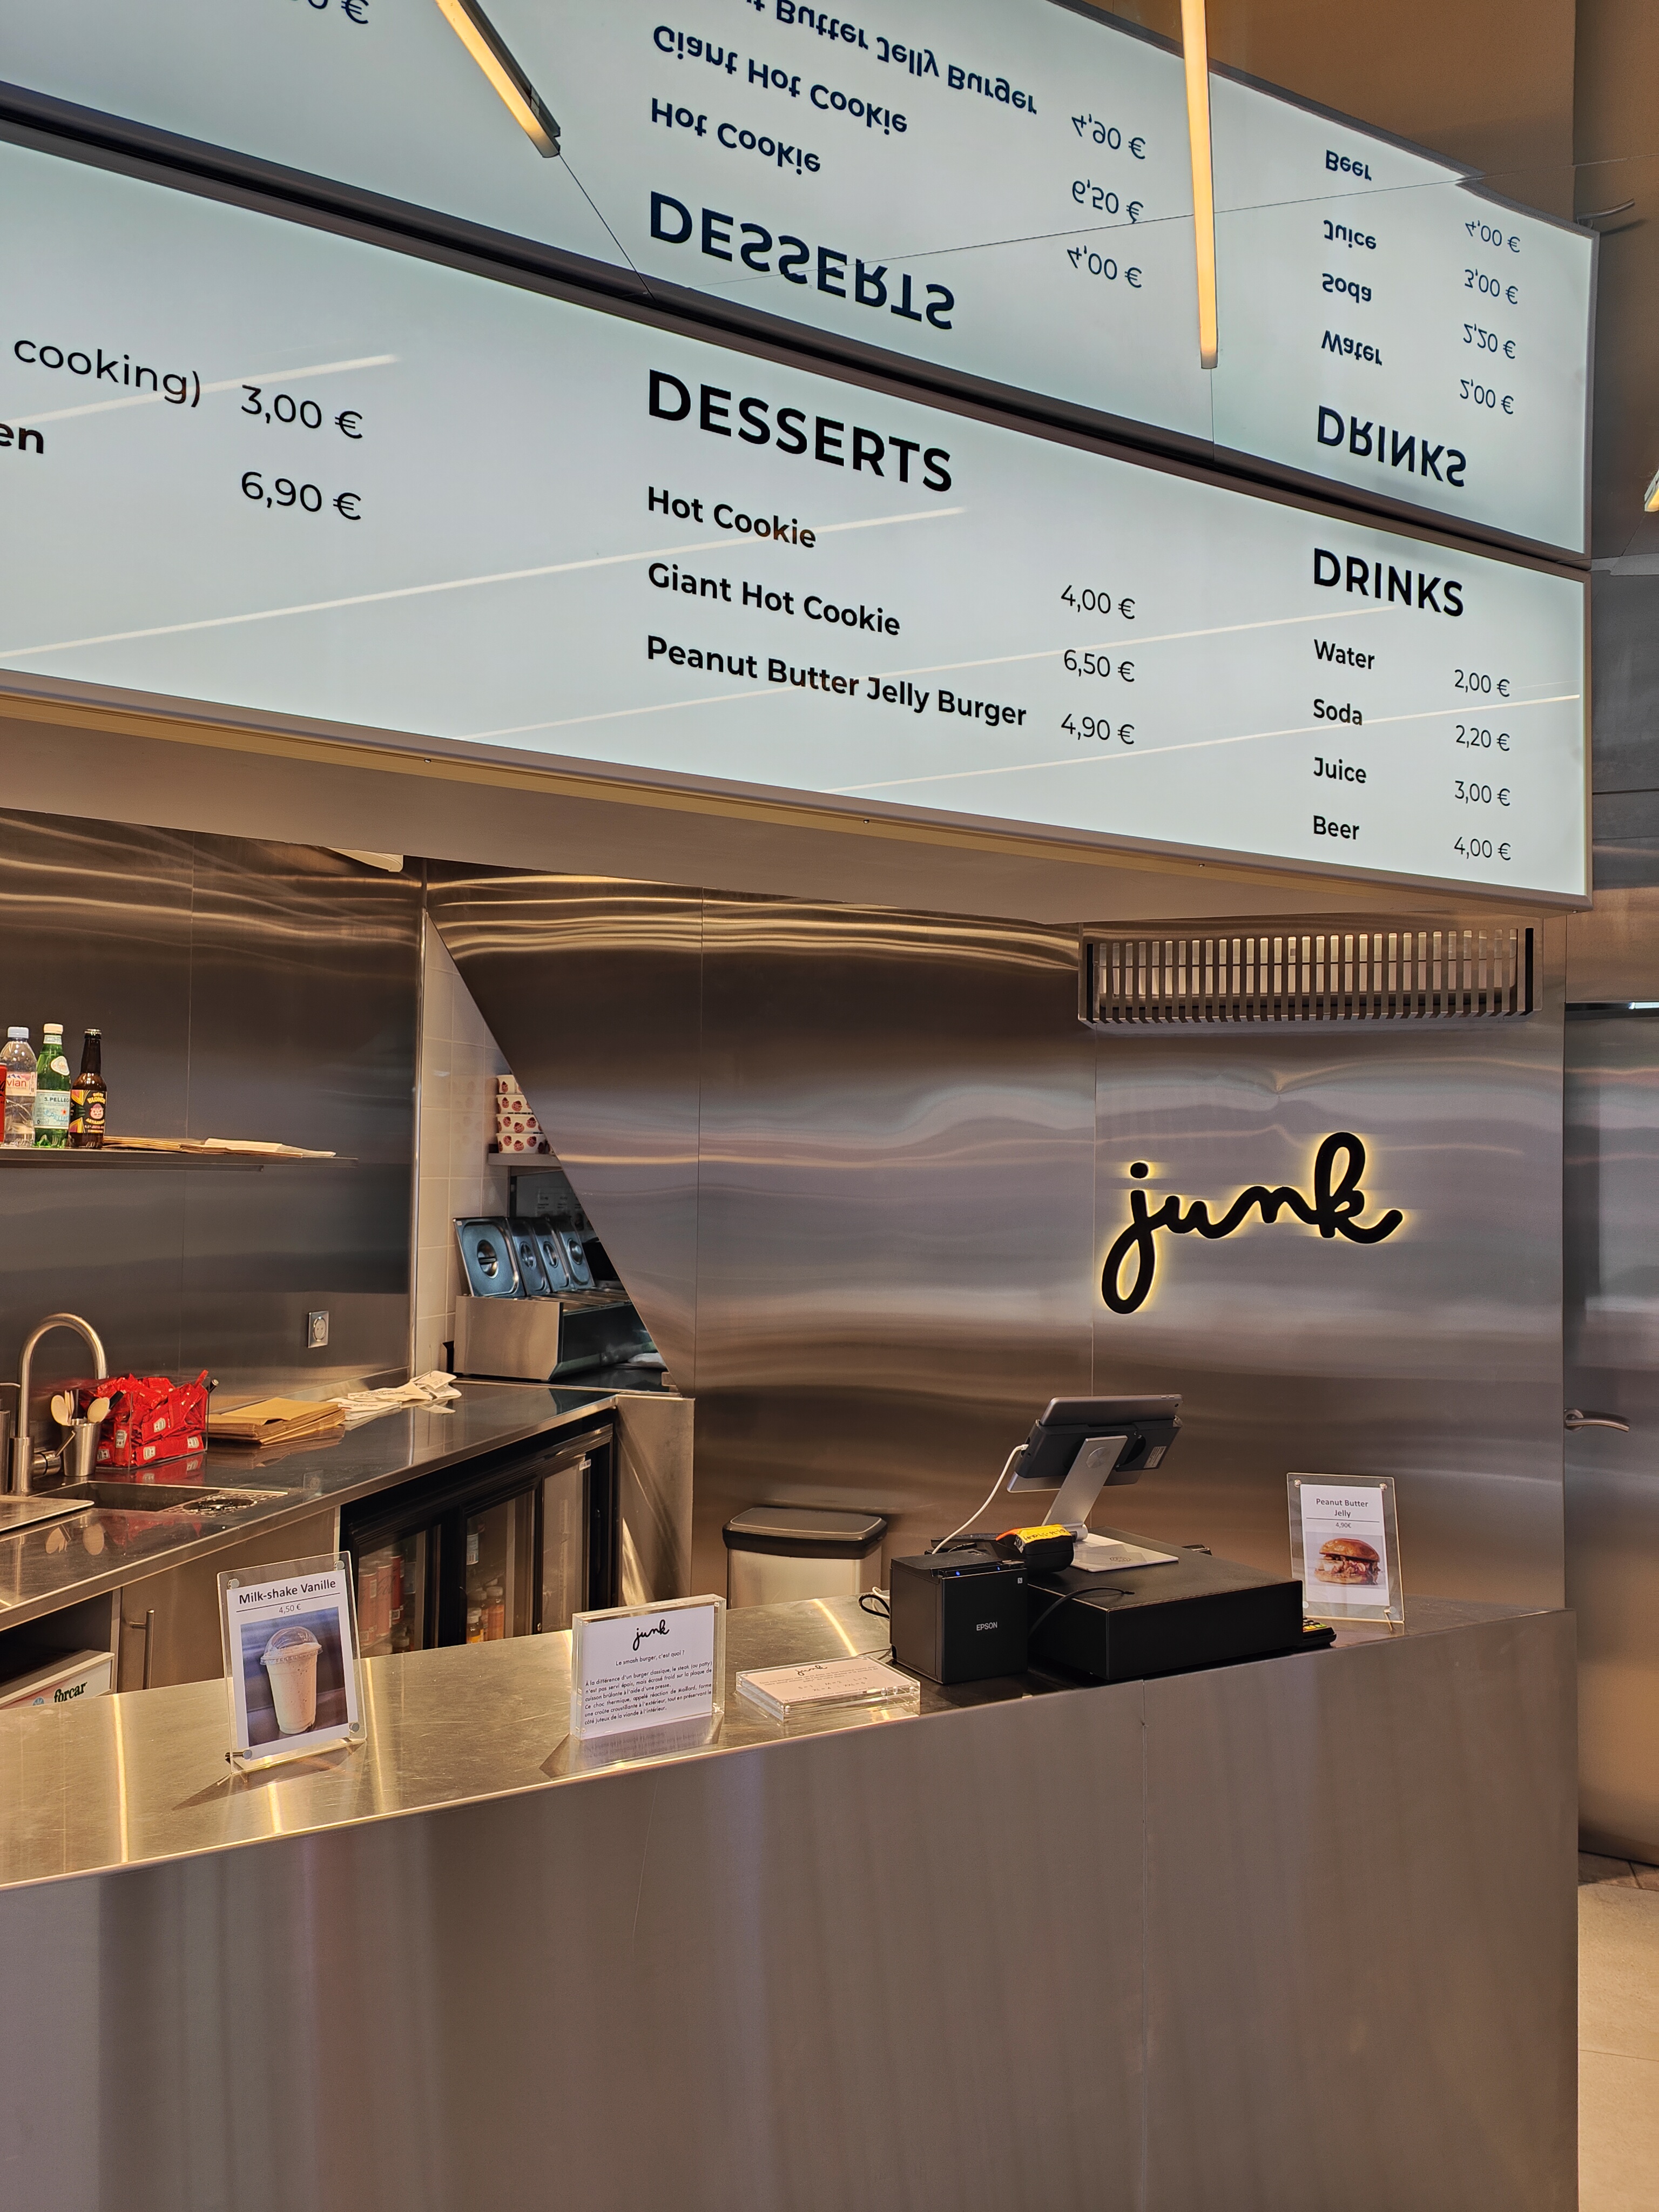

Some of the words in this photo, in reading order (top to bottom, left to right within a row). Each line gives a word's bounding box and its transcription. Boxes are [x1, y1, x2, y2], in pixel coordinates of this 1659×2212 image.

[15, 340, 200, 408] cooking)
[241, 385, 322, 429] 3,00
[649, 369, 952, 492] DESSERTS
[242, 471, 322, 512] 6,90
[649, 486, 703, 523] Hot
[714, 504, 815, 548] Cookie
[1314, 548, 1463, 617] DRINKS
[649, 563, 731, 602] Giant
[743, 582, 794, 615] Hot
[804, 596, 900, 635] Cookie
[1061, 585, 1111, 613] 4,00
[1064, 649, 1110, 677] 6,50
[1314, 639, 1375, 669] Water
[648, 635, 758, 678] Peanut
[768, 658, 859, 696] Butter
[867, 677, 929, 713] Jelly
[939, 690, 1027, 726] Burger
[1455, 669, 1491, 693] 2,00
[1313, 699, 1362, 725] Soda
[1061, 714, 1110, 740] 4,90
[1456, 725, 1491, 748] 2,20
[1313, 757, 1366, 784] Juice
[1455, 780, 1492, 804] 3,00
[1313, 815, 1359, 840] Beer
[1454, 837, 1492, 859] 4,00
[7, 1079, 26, 1087] vian
[1102, 1132, 1402, 1314] junk
[1334, 1510, 1351, 1518] Jelly
[239, 1586, 298, 1604] Milk-shake
[300, 1579, 336, 1593] Vanille
[279, 1604, 294, 1614] 4,50
[632, 1619, 670, 1651] junk
[976, 1621, 997, 1631] EPSON
[623, 1656, 638, 1665] smash
[671, 1650, 682, 1658] quoi
[699, 1661, 712, 1669] patty)
[54, 1682, 87, 1703] forcar
[603, 1691, 622, 1699] brûlante
[606, 1698, 631, 1706] thermique,
[633, 1694, 648, 1702] appelé
[678, 1684, 697, 1692] Maillard,
[610, 1704, 638, 1713] croustillante
[683, 1691, 706, 1701] préservant
